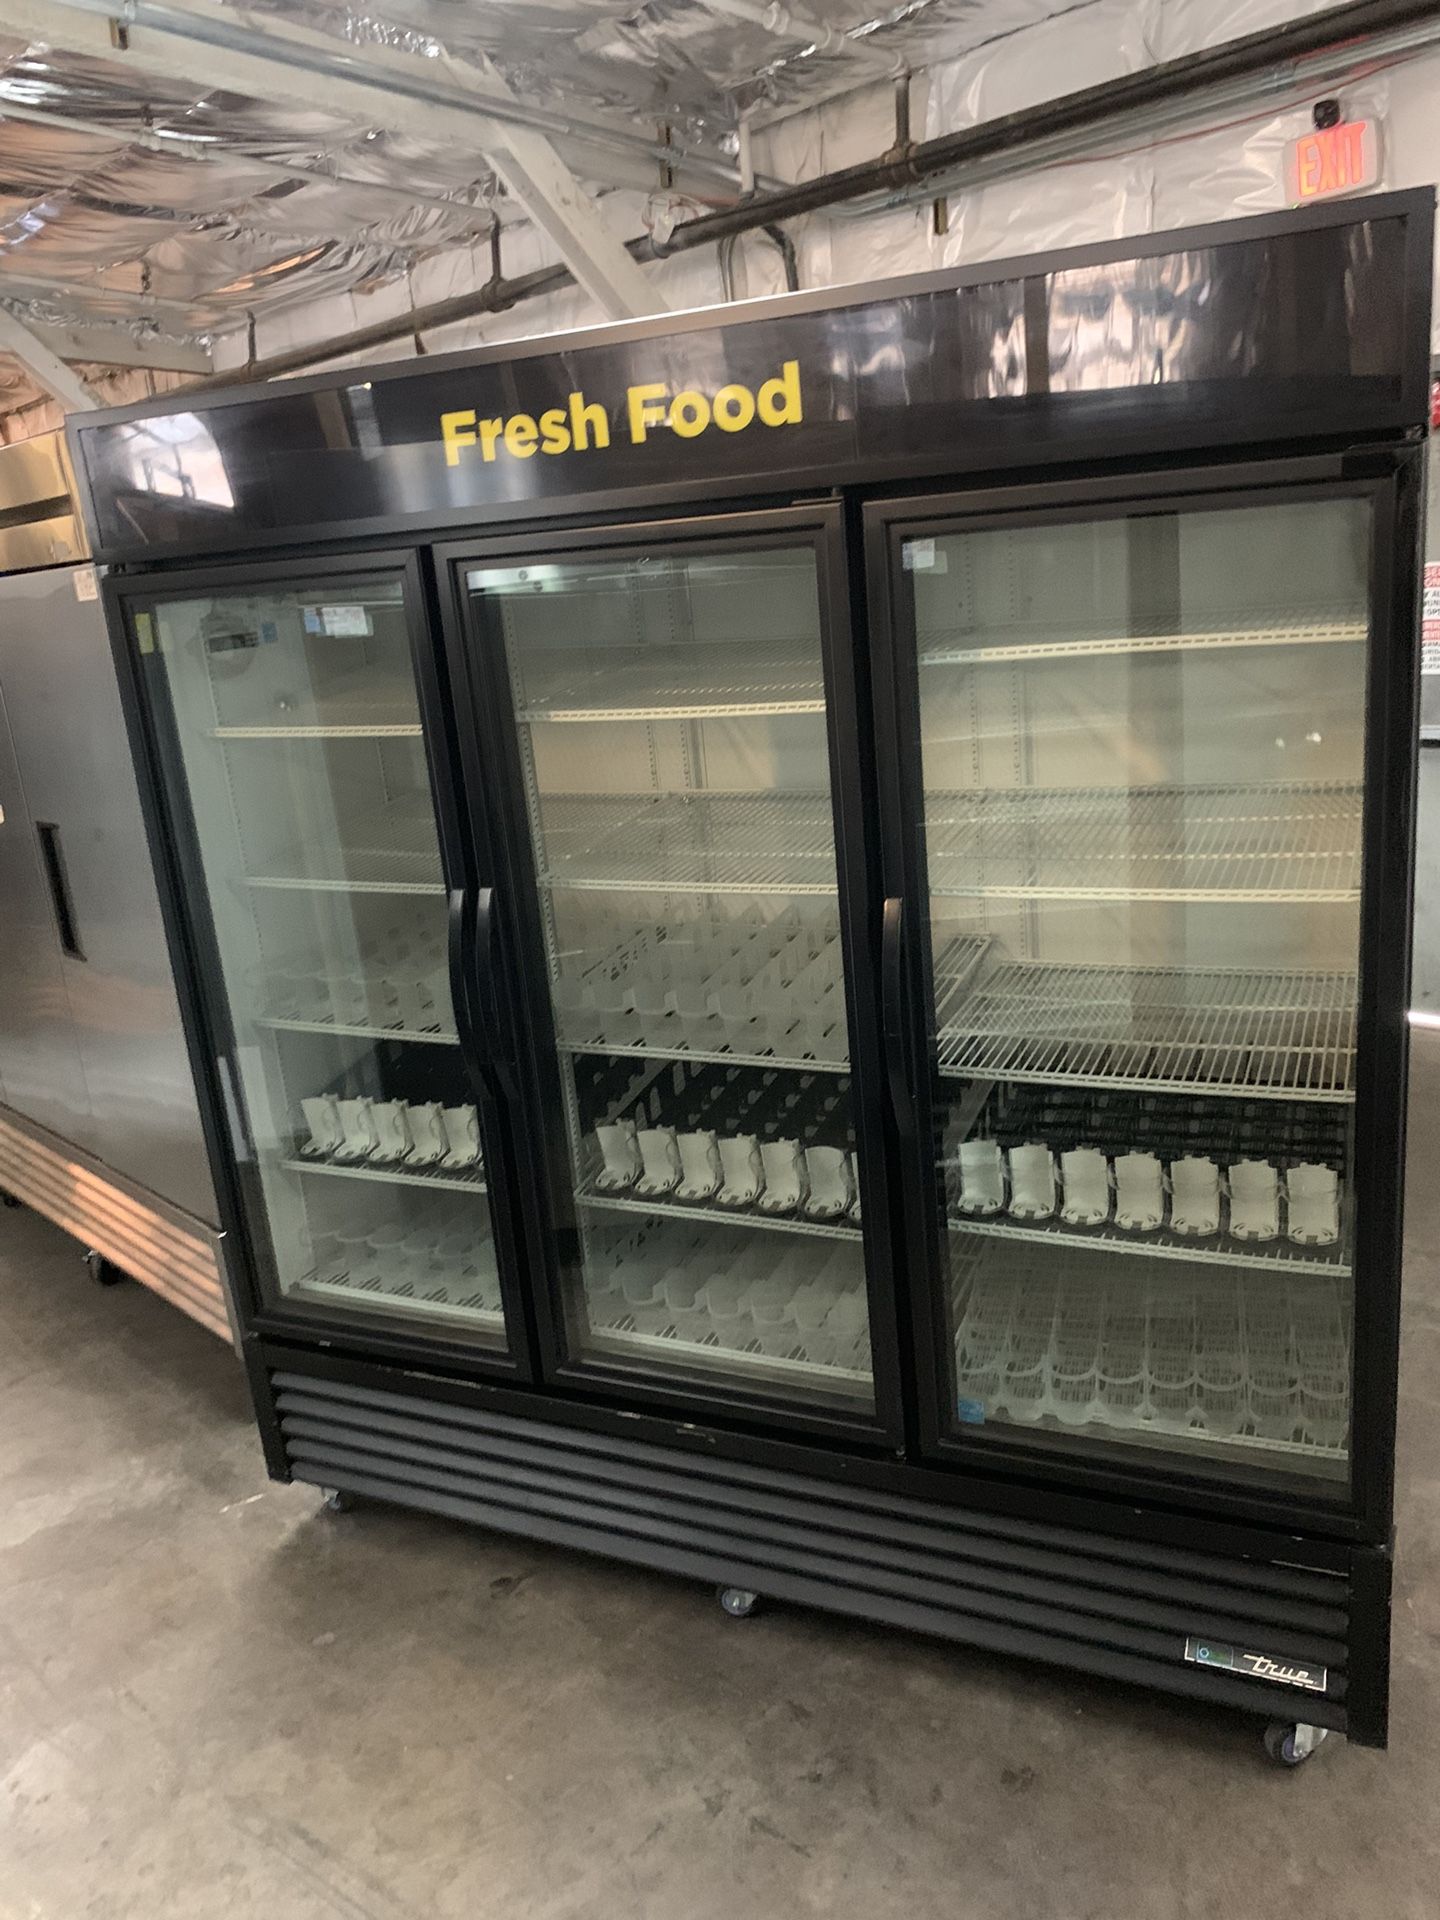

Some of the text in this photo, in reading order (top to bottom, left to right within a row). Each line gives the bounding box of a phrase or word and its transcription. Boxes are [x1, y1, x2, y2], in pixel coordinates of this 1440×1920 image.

[1297, 122, 1367, 197] EXIT
[441, 360, 803, 467] Fresh Food
